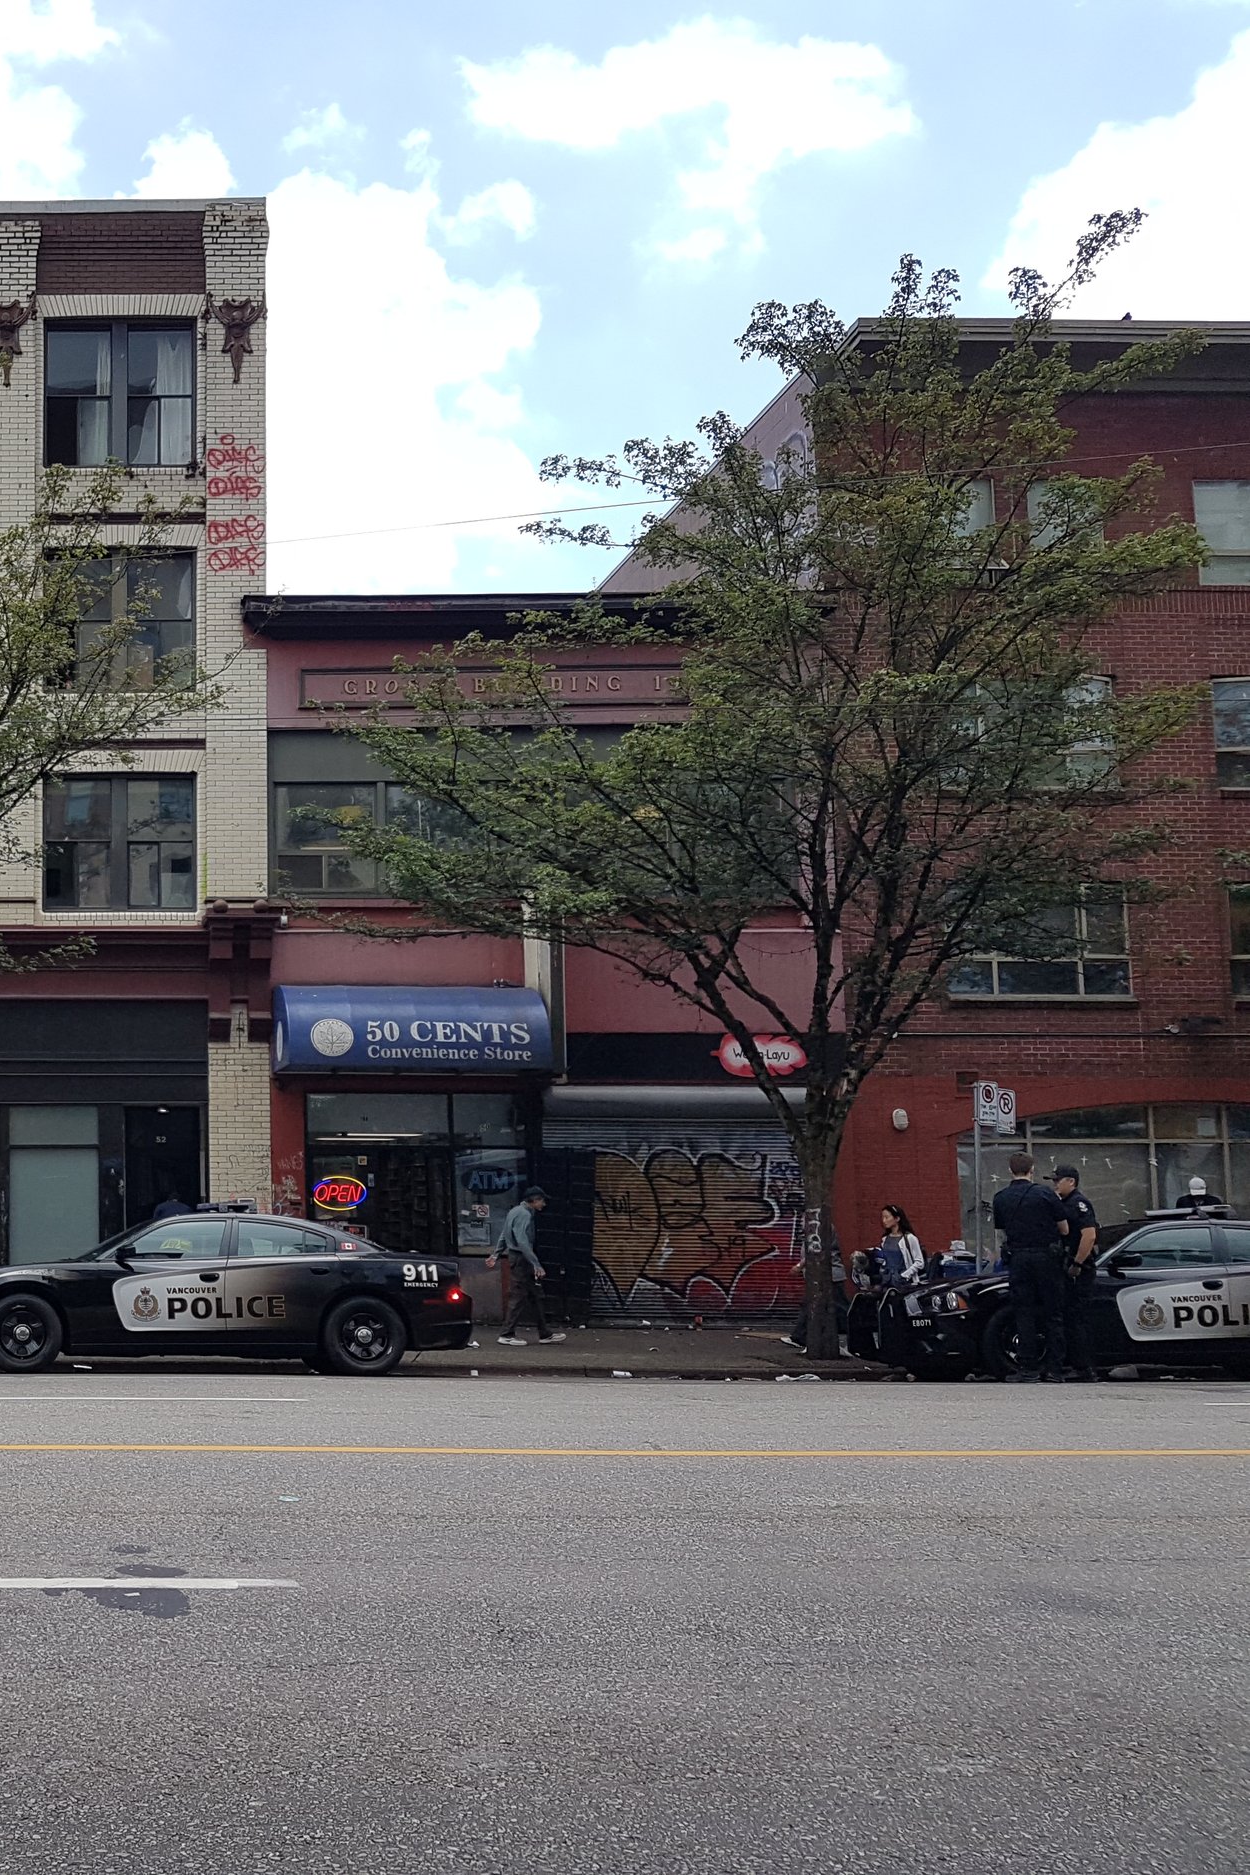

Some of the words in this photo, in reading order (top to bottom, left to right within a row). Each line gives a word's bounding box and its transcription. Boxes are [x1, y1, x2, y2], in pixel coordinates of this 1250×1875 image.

[366, 1020, 400, 1042] 50
[410, 1020, 531, 1044] CENTS
[367, 1045, 479, 1060] Convenience
[484, 1046, 532, 1061] Store
[468, 1171, 510, 1190] ATM
[315, 1184, 363, 1202] OPEN
[403, 1264, 438, 1281] 911
[166, 1286, 217, 1294] VANCOUVER
[1170, 1294, 1223, 1303] VANCOUVER
[166, 1295, 286, 1320] POLICE
[1173, 1303, 1250, 1329] POLI
